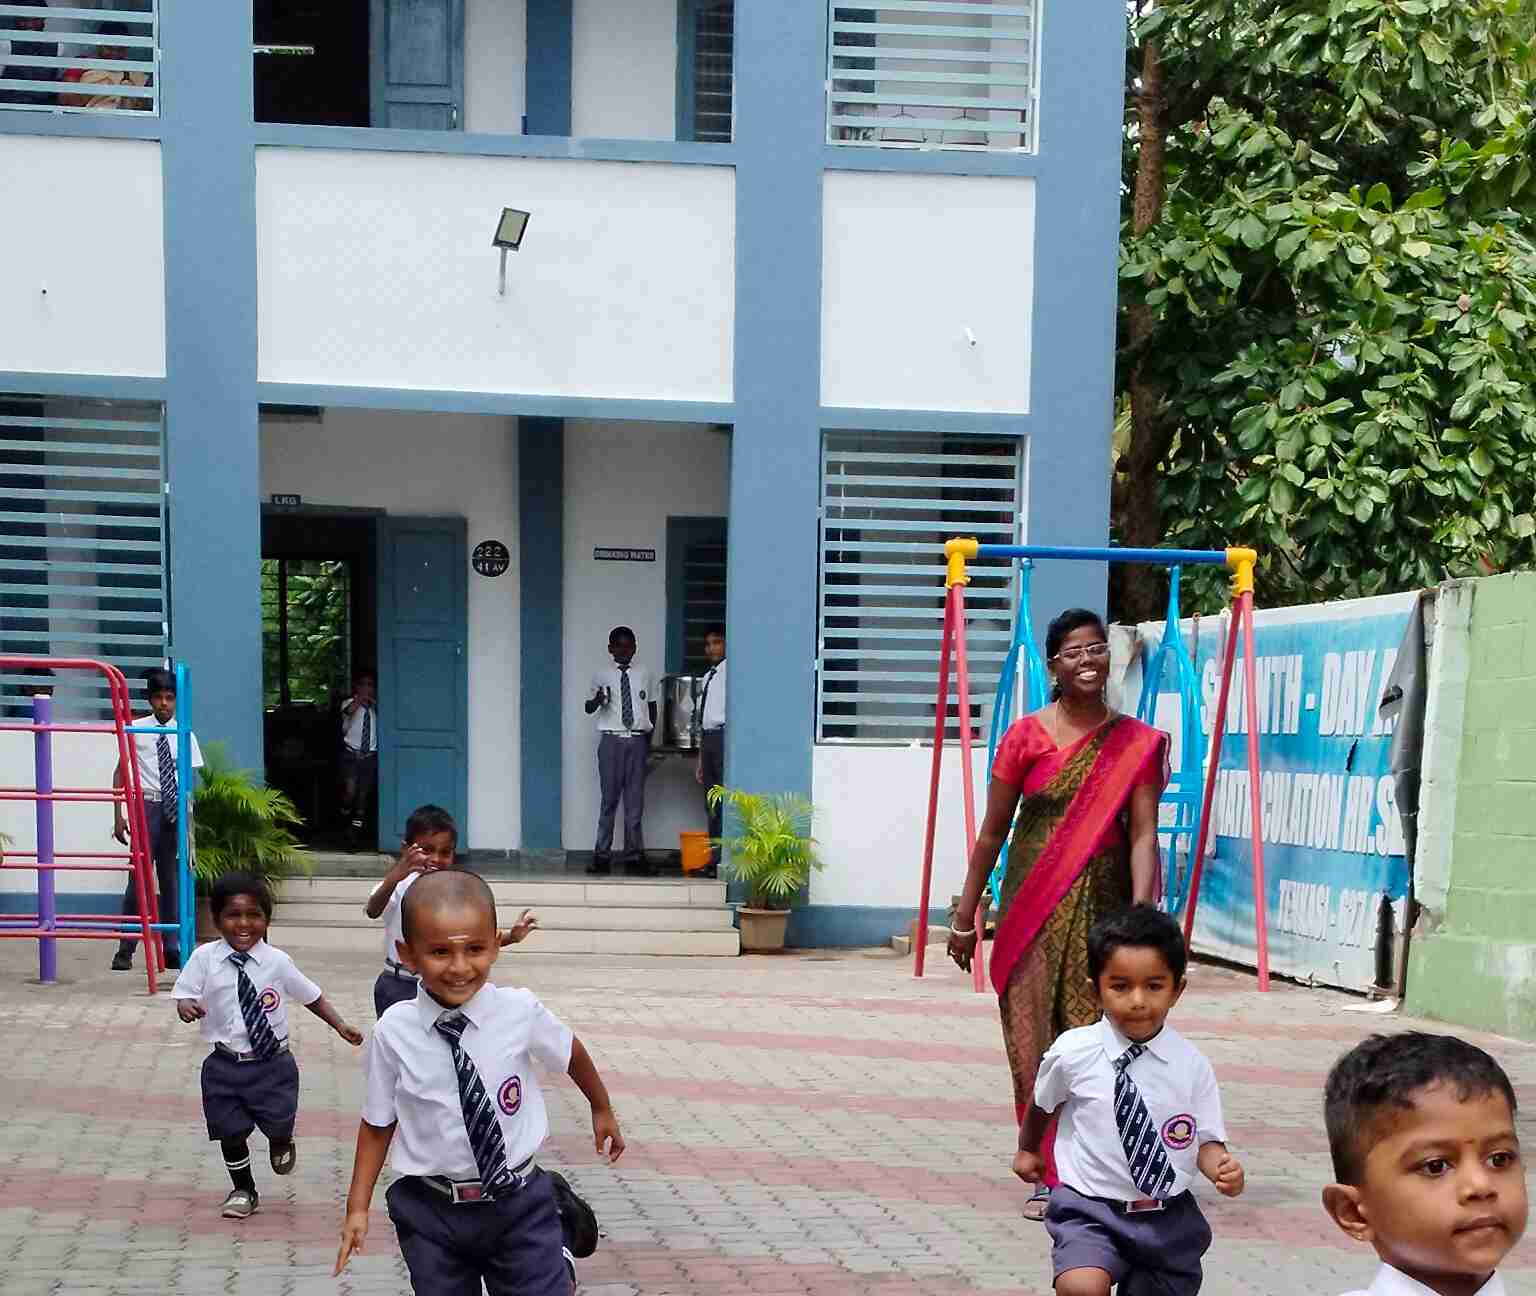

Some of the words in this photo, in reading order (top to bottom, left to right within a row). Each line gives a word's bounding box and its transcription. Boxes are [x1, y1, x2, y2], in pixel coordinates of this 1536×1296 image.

[1199, 655, 1303, 736] SVNTH
[1319, 650, 1376, 737] DAY
[1214, 769, 1345, 851] MATRCULATION
